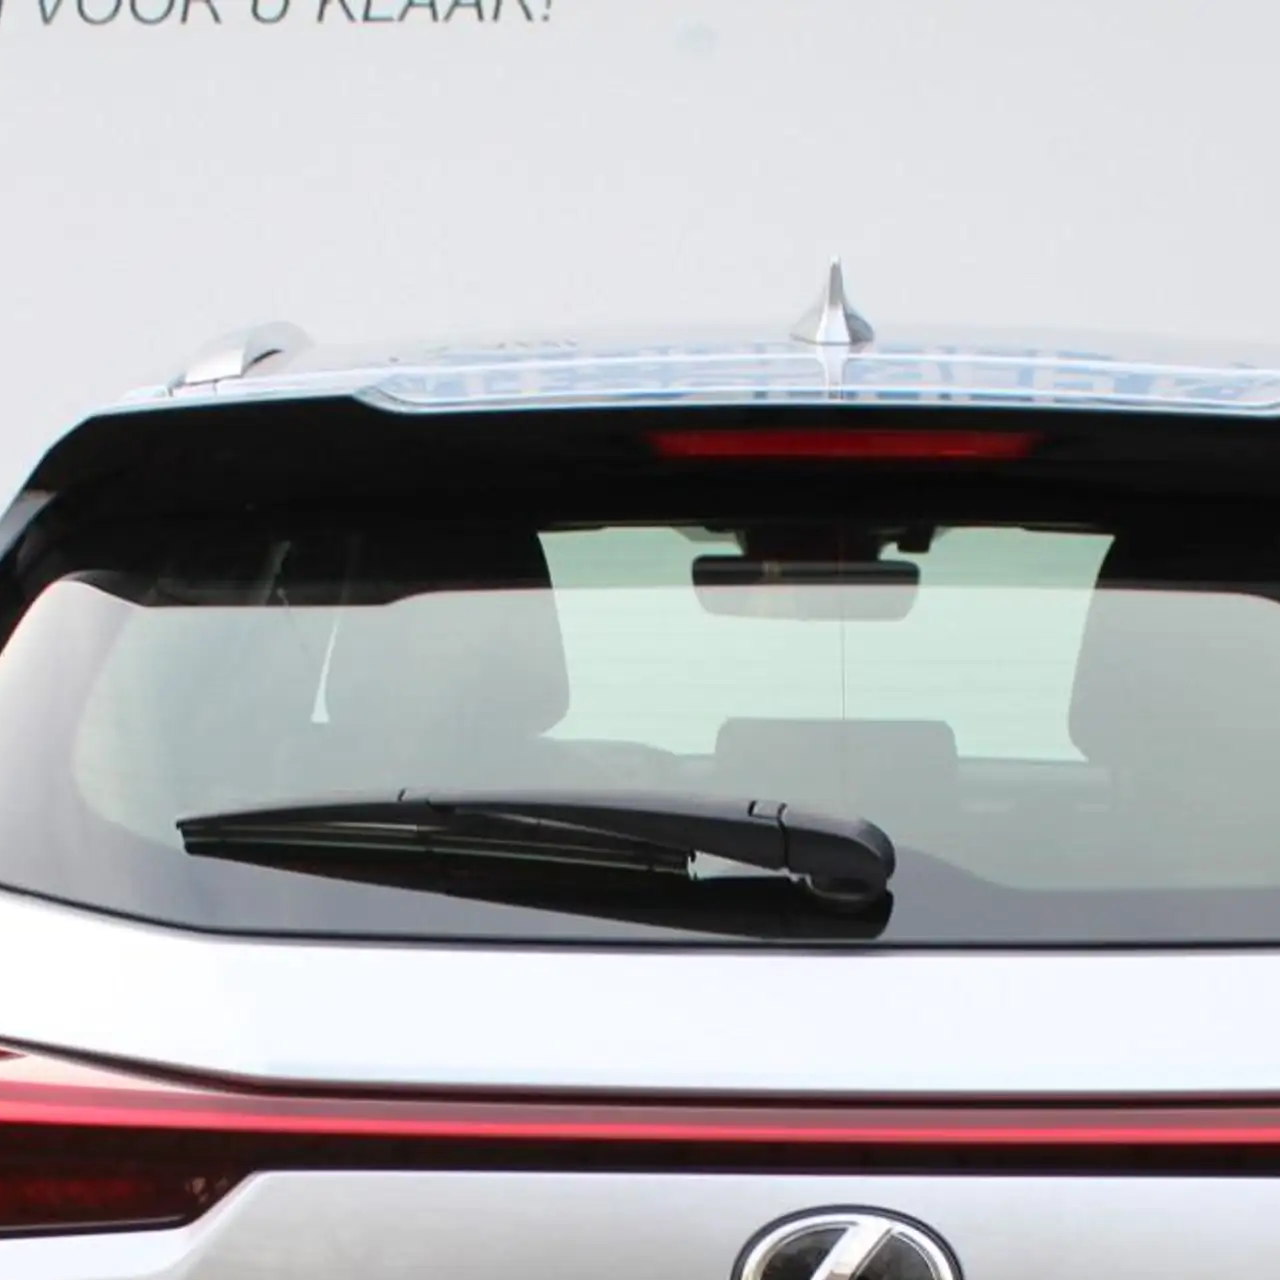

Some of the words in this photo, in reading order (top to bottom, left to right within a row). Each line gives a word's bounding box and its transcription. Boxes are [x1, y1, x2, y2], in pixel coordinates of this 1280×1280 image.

[39, 0, 222, 25] VOOR
[250, 0, 291, 24] U
[316, 0, 553, 23] KLAAR!
